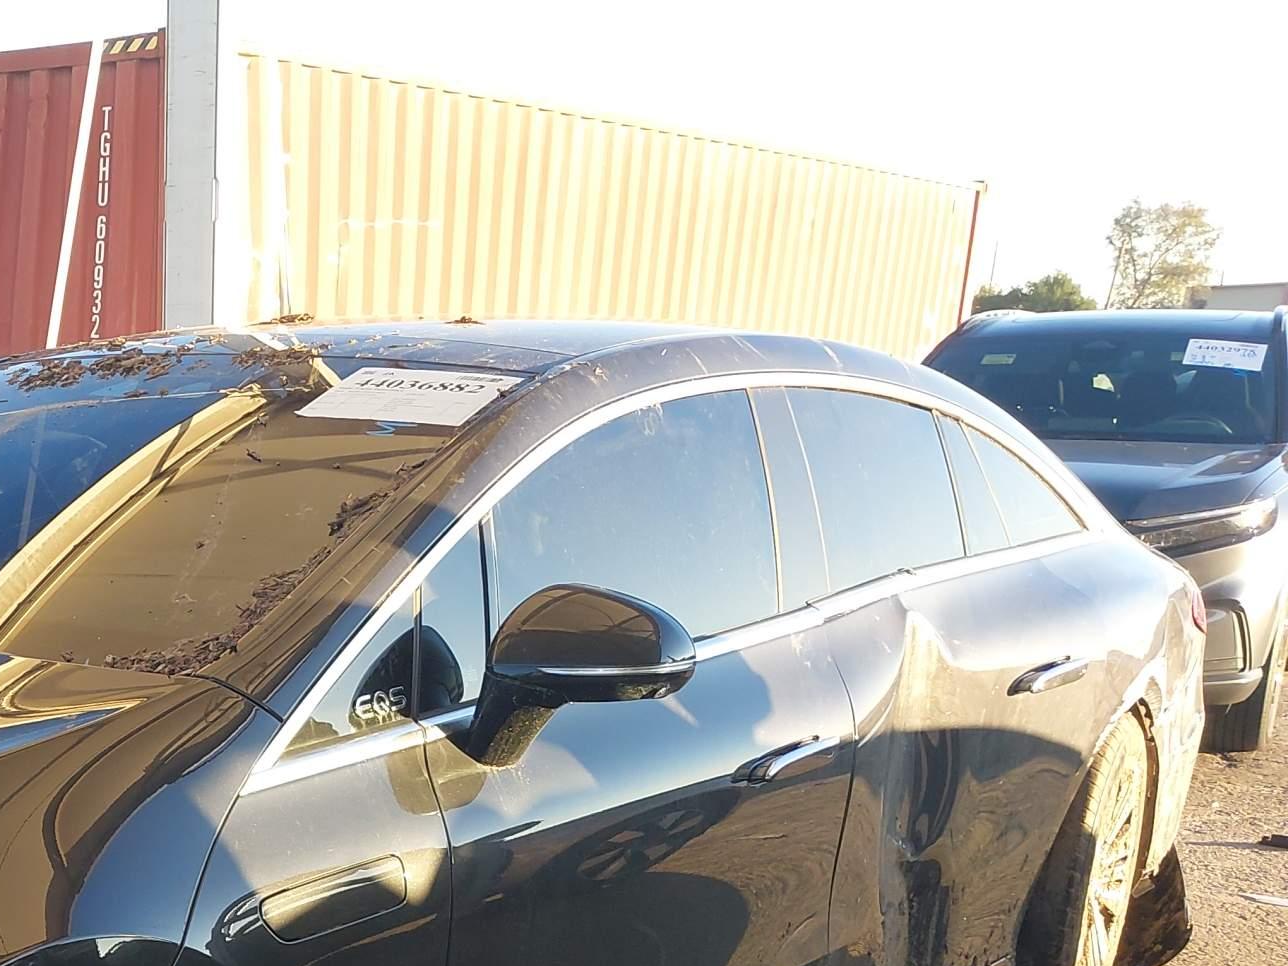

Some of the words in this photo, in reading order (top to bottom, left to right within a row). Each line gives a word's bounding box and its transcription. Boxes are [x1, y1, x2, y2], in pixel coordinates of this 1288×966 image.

[97, 106, 112, 207] TGHU
[90, 215, 107, 338] 60932
[355, 377, 486, 394] 44036882
[355, 686, 407, 719] EQS
